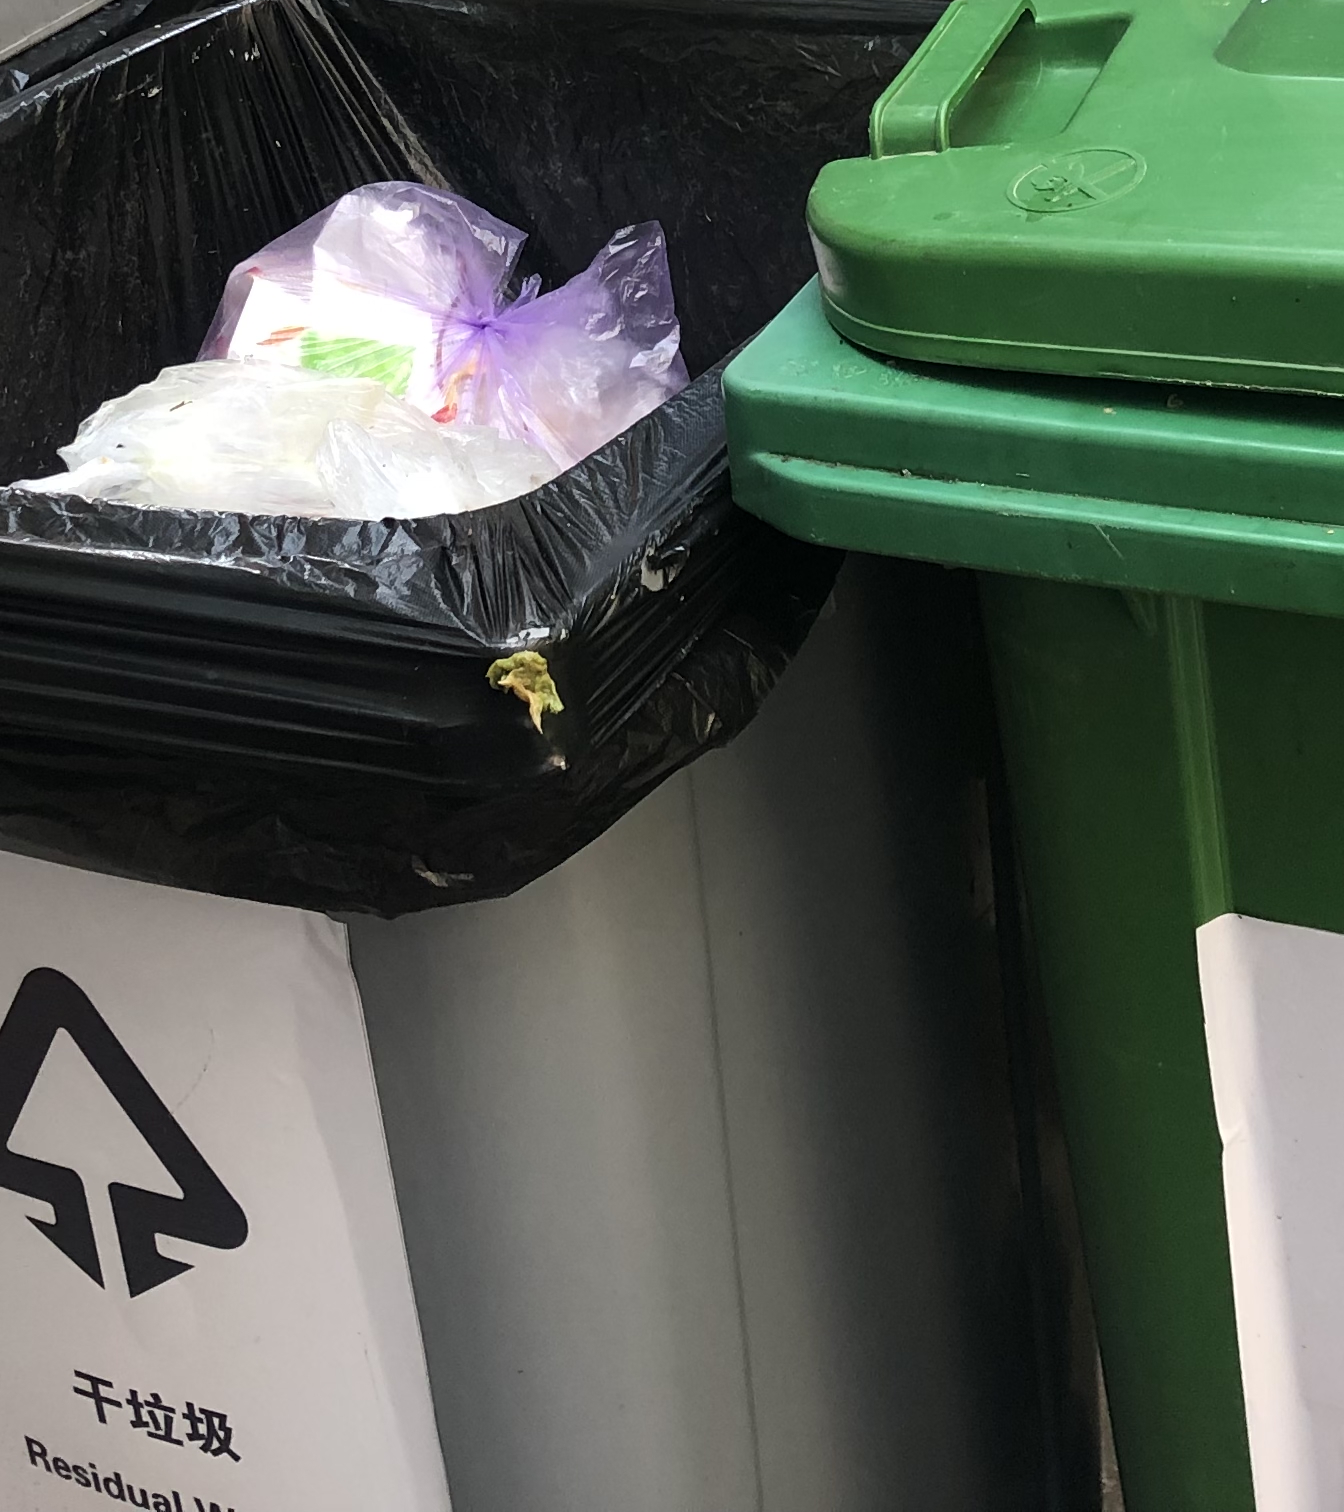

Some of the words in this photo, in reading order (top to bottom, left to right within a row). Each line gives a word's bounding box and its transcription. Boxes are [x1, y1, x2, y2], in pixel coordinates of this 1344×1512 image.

[72, 1368, 242, 1463] 干垃圾
[23, 1434, 183, 1512] Residual
